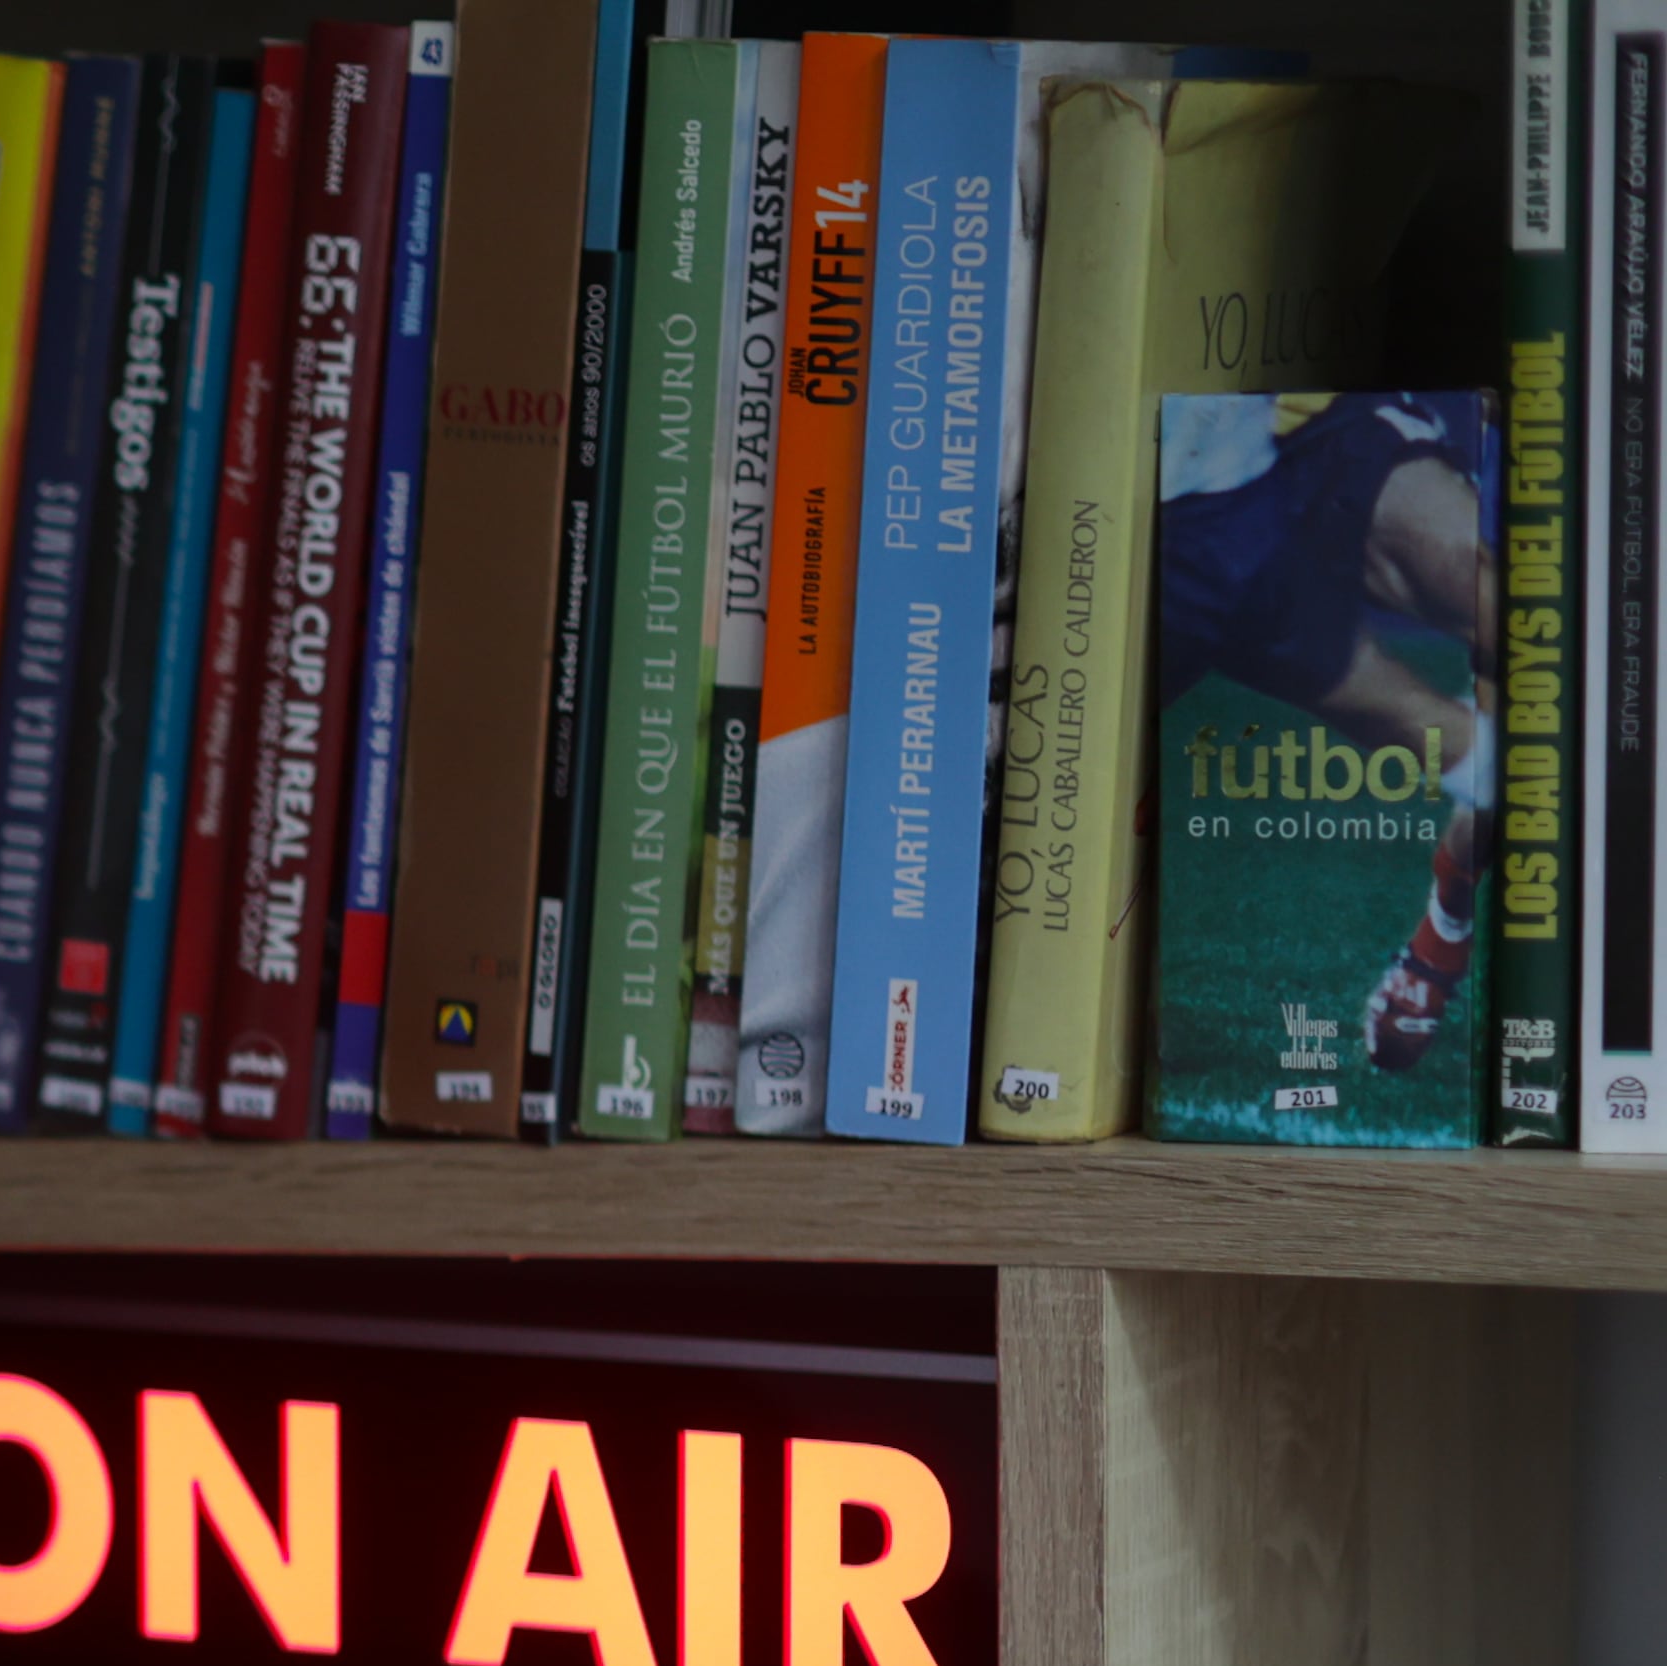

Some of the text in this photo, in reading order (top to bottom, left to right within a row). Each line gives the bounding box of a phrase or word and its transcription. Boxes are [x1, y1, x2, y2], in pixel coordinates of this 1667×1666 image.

[322, 62, 352, 196] PASSINGHAM
[669, 119, 703, 283] Andrés Salcedo
[1525, 74, 1551, 234] JEAN-PHILIPPE
[400, 172, 433, 337] Wilmar Cabrera
[806, 179, 870, 406] CRUYFF 14
[110, 274, 180, 490] Testigos
[440, 382, 568, 428] GABO
[581, 283, 607, 439] anos 90/2000
[725, 117, 790, 623] JUAN PABLO VARSKY
[787, 347, 809, 399] JOHAN
[883, 175, 938, 550] PEP GUARDIOLA
[936, 175, 992, 554] LA METAMORFOSIS
[1620, 54, 1650, 753] FERNANDO ARAÚJO VÉLEZ NO ERA ERA FRAUDE
[16, 480, 80, 684] PERDÍAMOS
[798, 486, 828, 656] LA AUTOBIOGRAFÍA
[1503, 331, 1566, 940] LOS BAD BOYS DEL FÚTBOL
[237, 337, 316, 979] RELIVE THE FINALS HAPPENING TODAY
[259, 332, 356, 986] THE WORLD CUP IN REAL TIME
[620, 313, 698, 1007] EL DÍA EN QUE EL FÚTBOL MURIÓ
[1043, 499, 1100, 932] LUCAS CABALLERO CALDERON
[4, 697, 60, 811] NUNCA
[355, 758, 390, 908] Los fantasmas
[890, 601, 943, 920] MARTÍ PERARNAU
[994, 663, 1050, 924] YO, LUCAS
[1184, 724, 1443, 803] fútbol
[1187, 811, 1437, 842] en colombia
[707, 717, 747, 995] MÁS QUE UN JUEGO
[695, 1087, 730, 1106] 197
[771, 1088, 806, 1107] 198
[882, 1098, 917, 1118] 199
[1012, 1082, 1050, 1101] 200
[1290, 1089, 1327, 1108] 201
[1512, 1091, 1549, 1110] 202
[1609, 1103, 1647, 1121] 203
